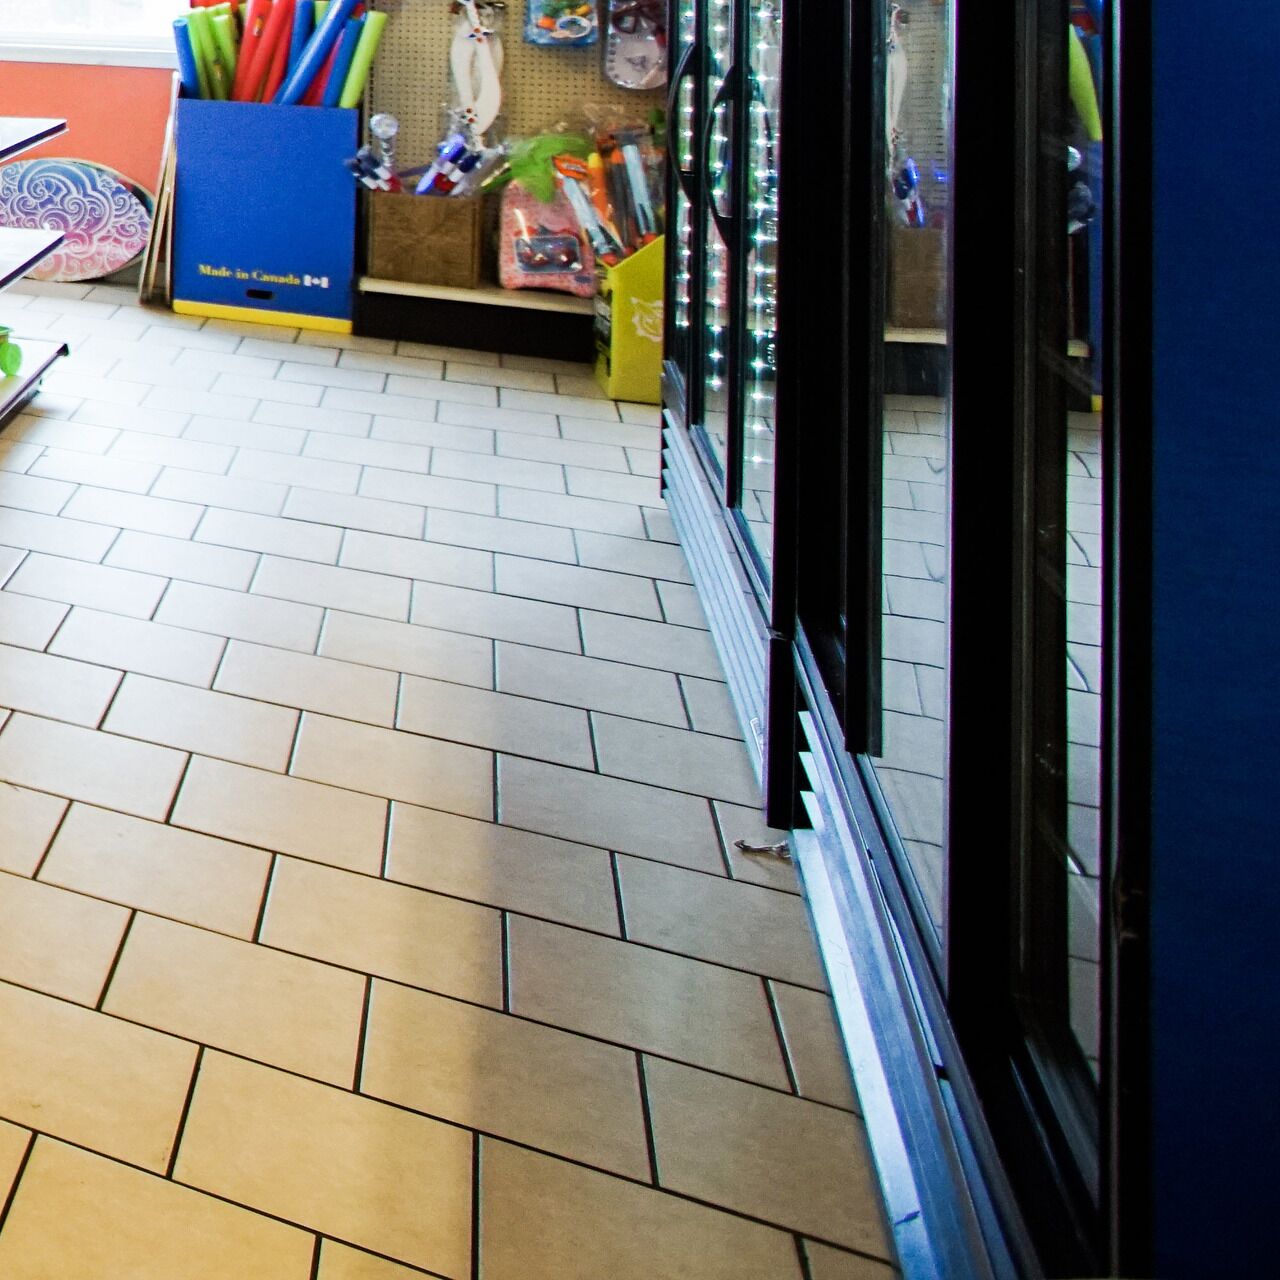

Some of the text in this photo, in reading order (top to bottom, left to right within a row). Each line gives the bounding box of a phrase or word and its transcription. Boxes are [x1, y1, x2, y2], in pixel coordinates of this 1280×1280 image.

[198, 264, 301, 286] Made in Canada
